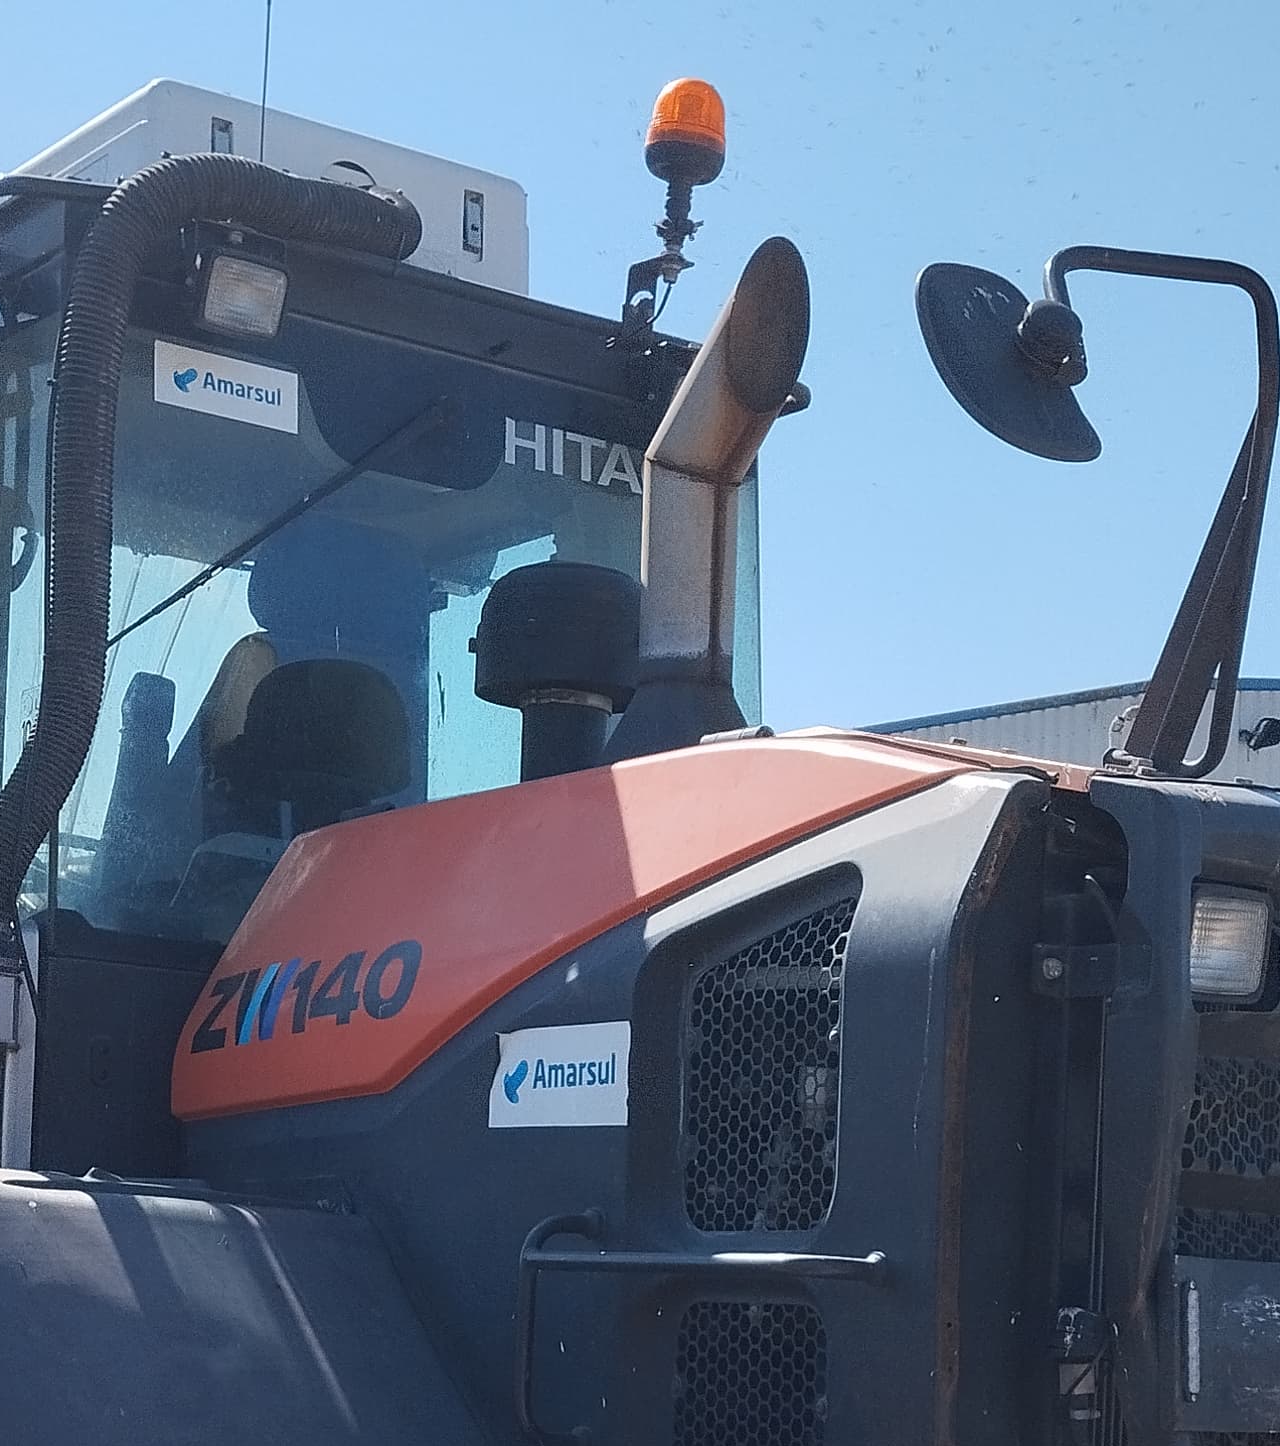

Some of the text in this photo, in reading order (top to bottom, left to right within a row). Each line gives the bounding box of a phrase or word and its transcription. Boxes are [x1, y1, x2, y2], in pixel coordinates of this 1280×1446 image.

[203, 371, 282, 406] Amarsul
[190, 939, 424, 1055] ZW140
[532, 1052, 616, 1090] Amarsul
